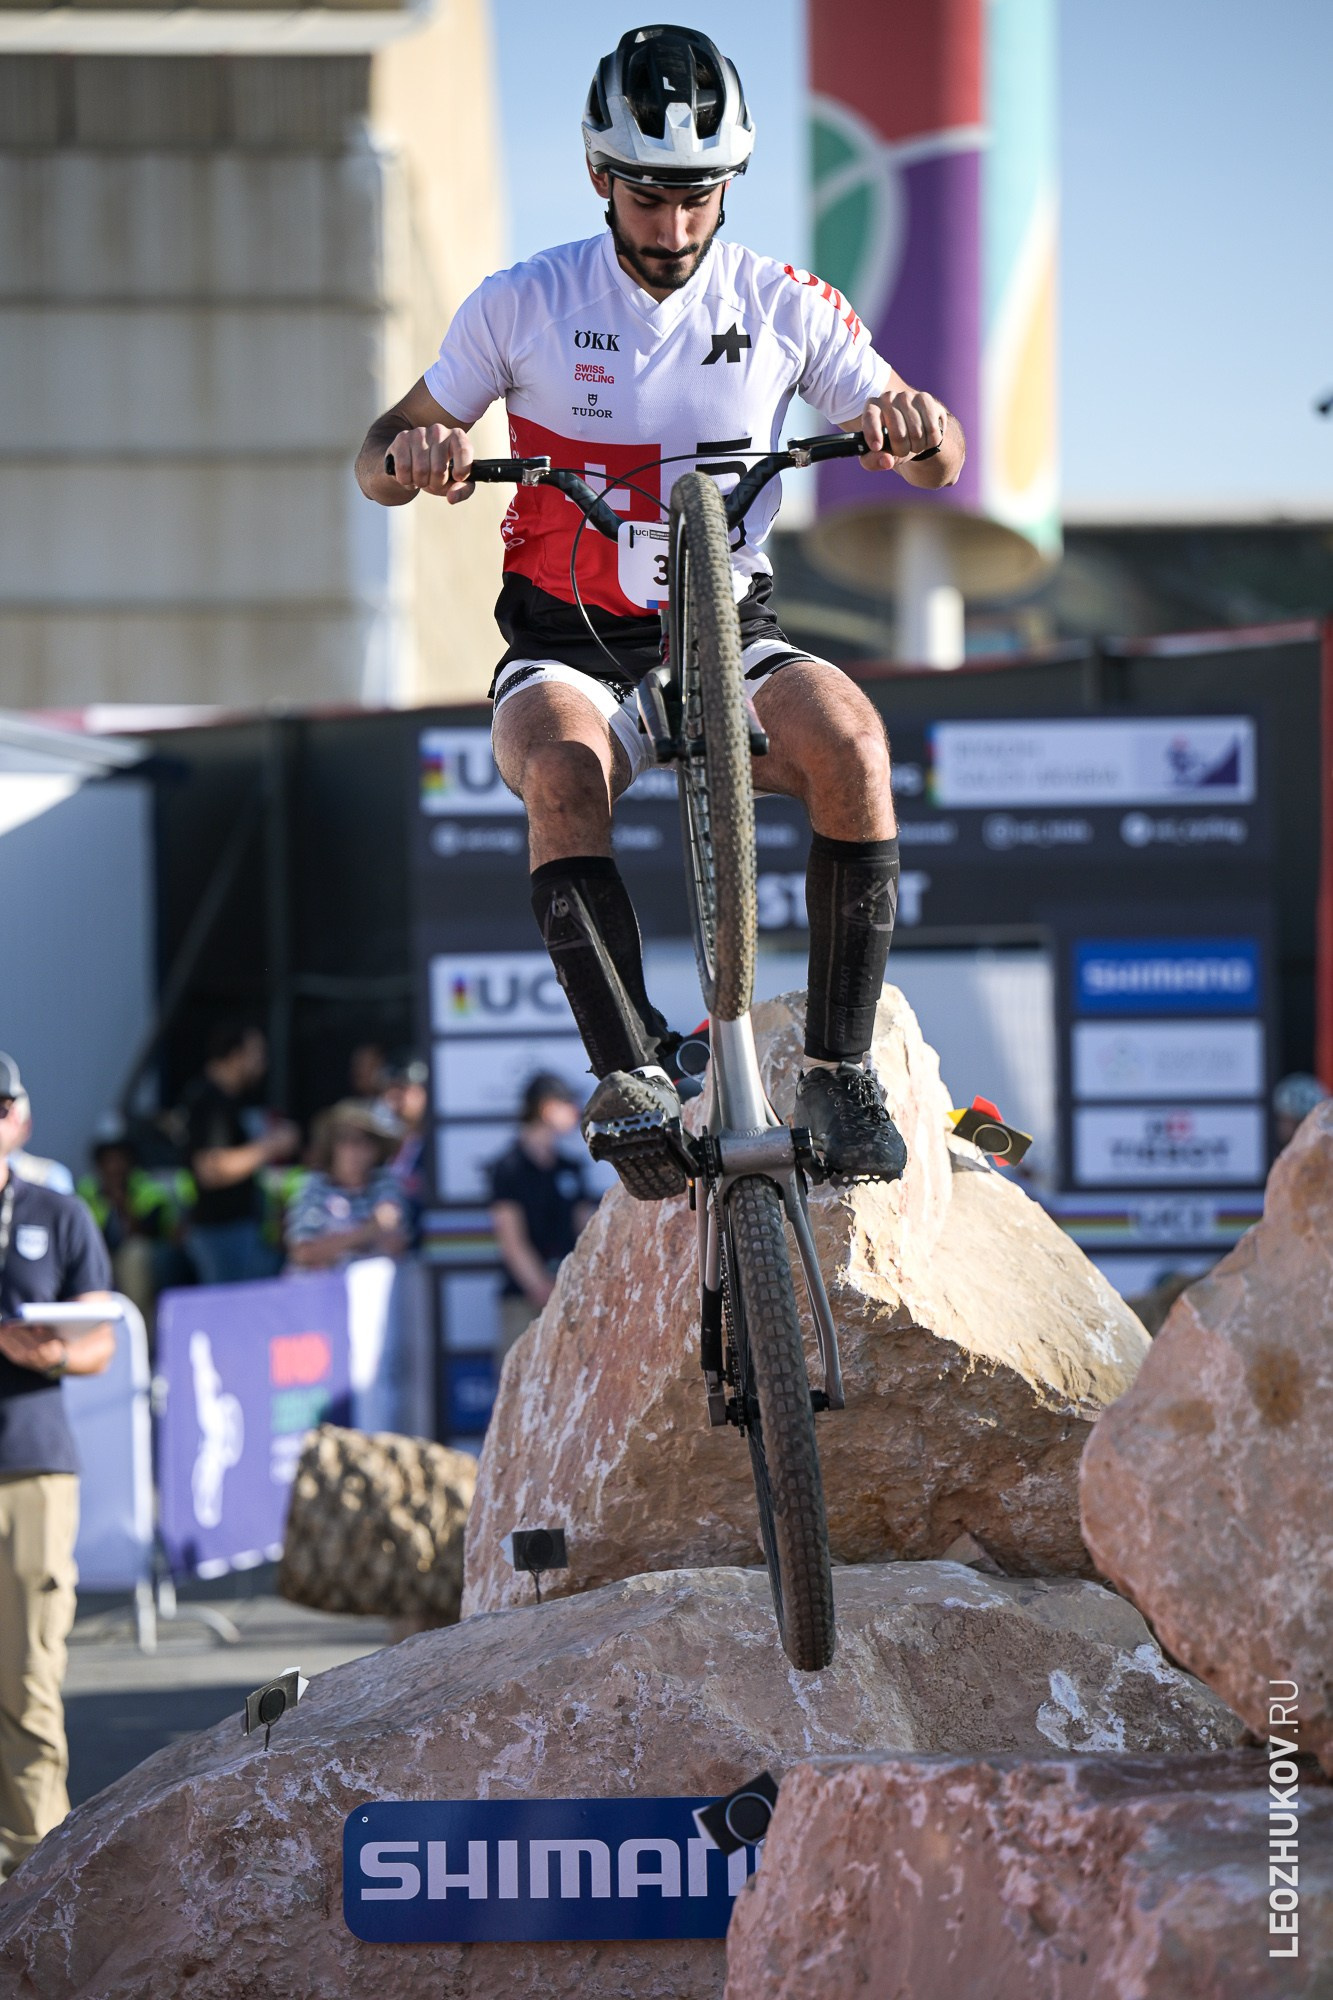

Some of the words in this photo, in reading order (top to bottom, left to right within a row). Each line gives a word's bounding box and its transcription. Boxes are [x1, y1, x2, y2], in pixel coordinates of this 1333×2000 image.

[574, 329, 621, 352] ÖKK
[575, 363, 605, 375] SWISS
[574, 372, 615, 385] CYCLING
[571, 406, 613, 419] TUDOR
[635, 529, 649, 537] UCI
